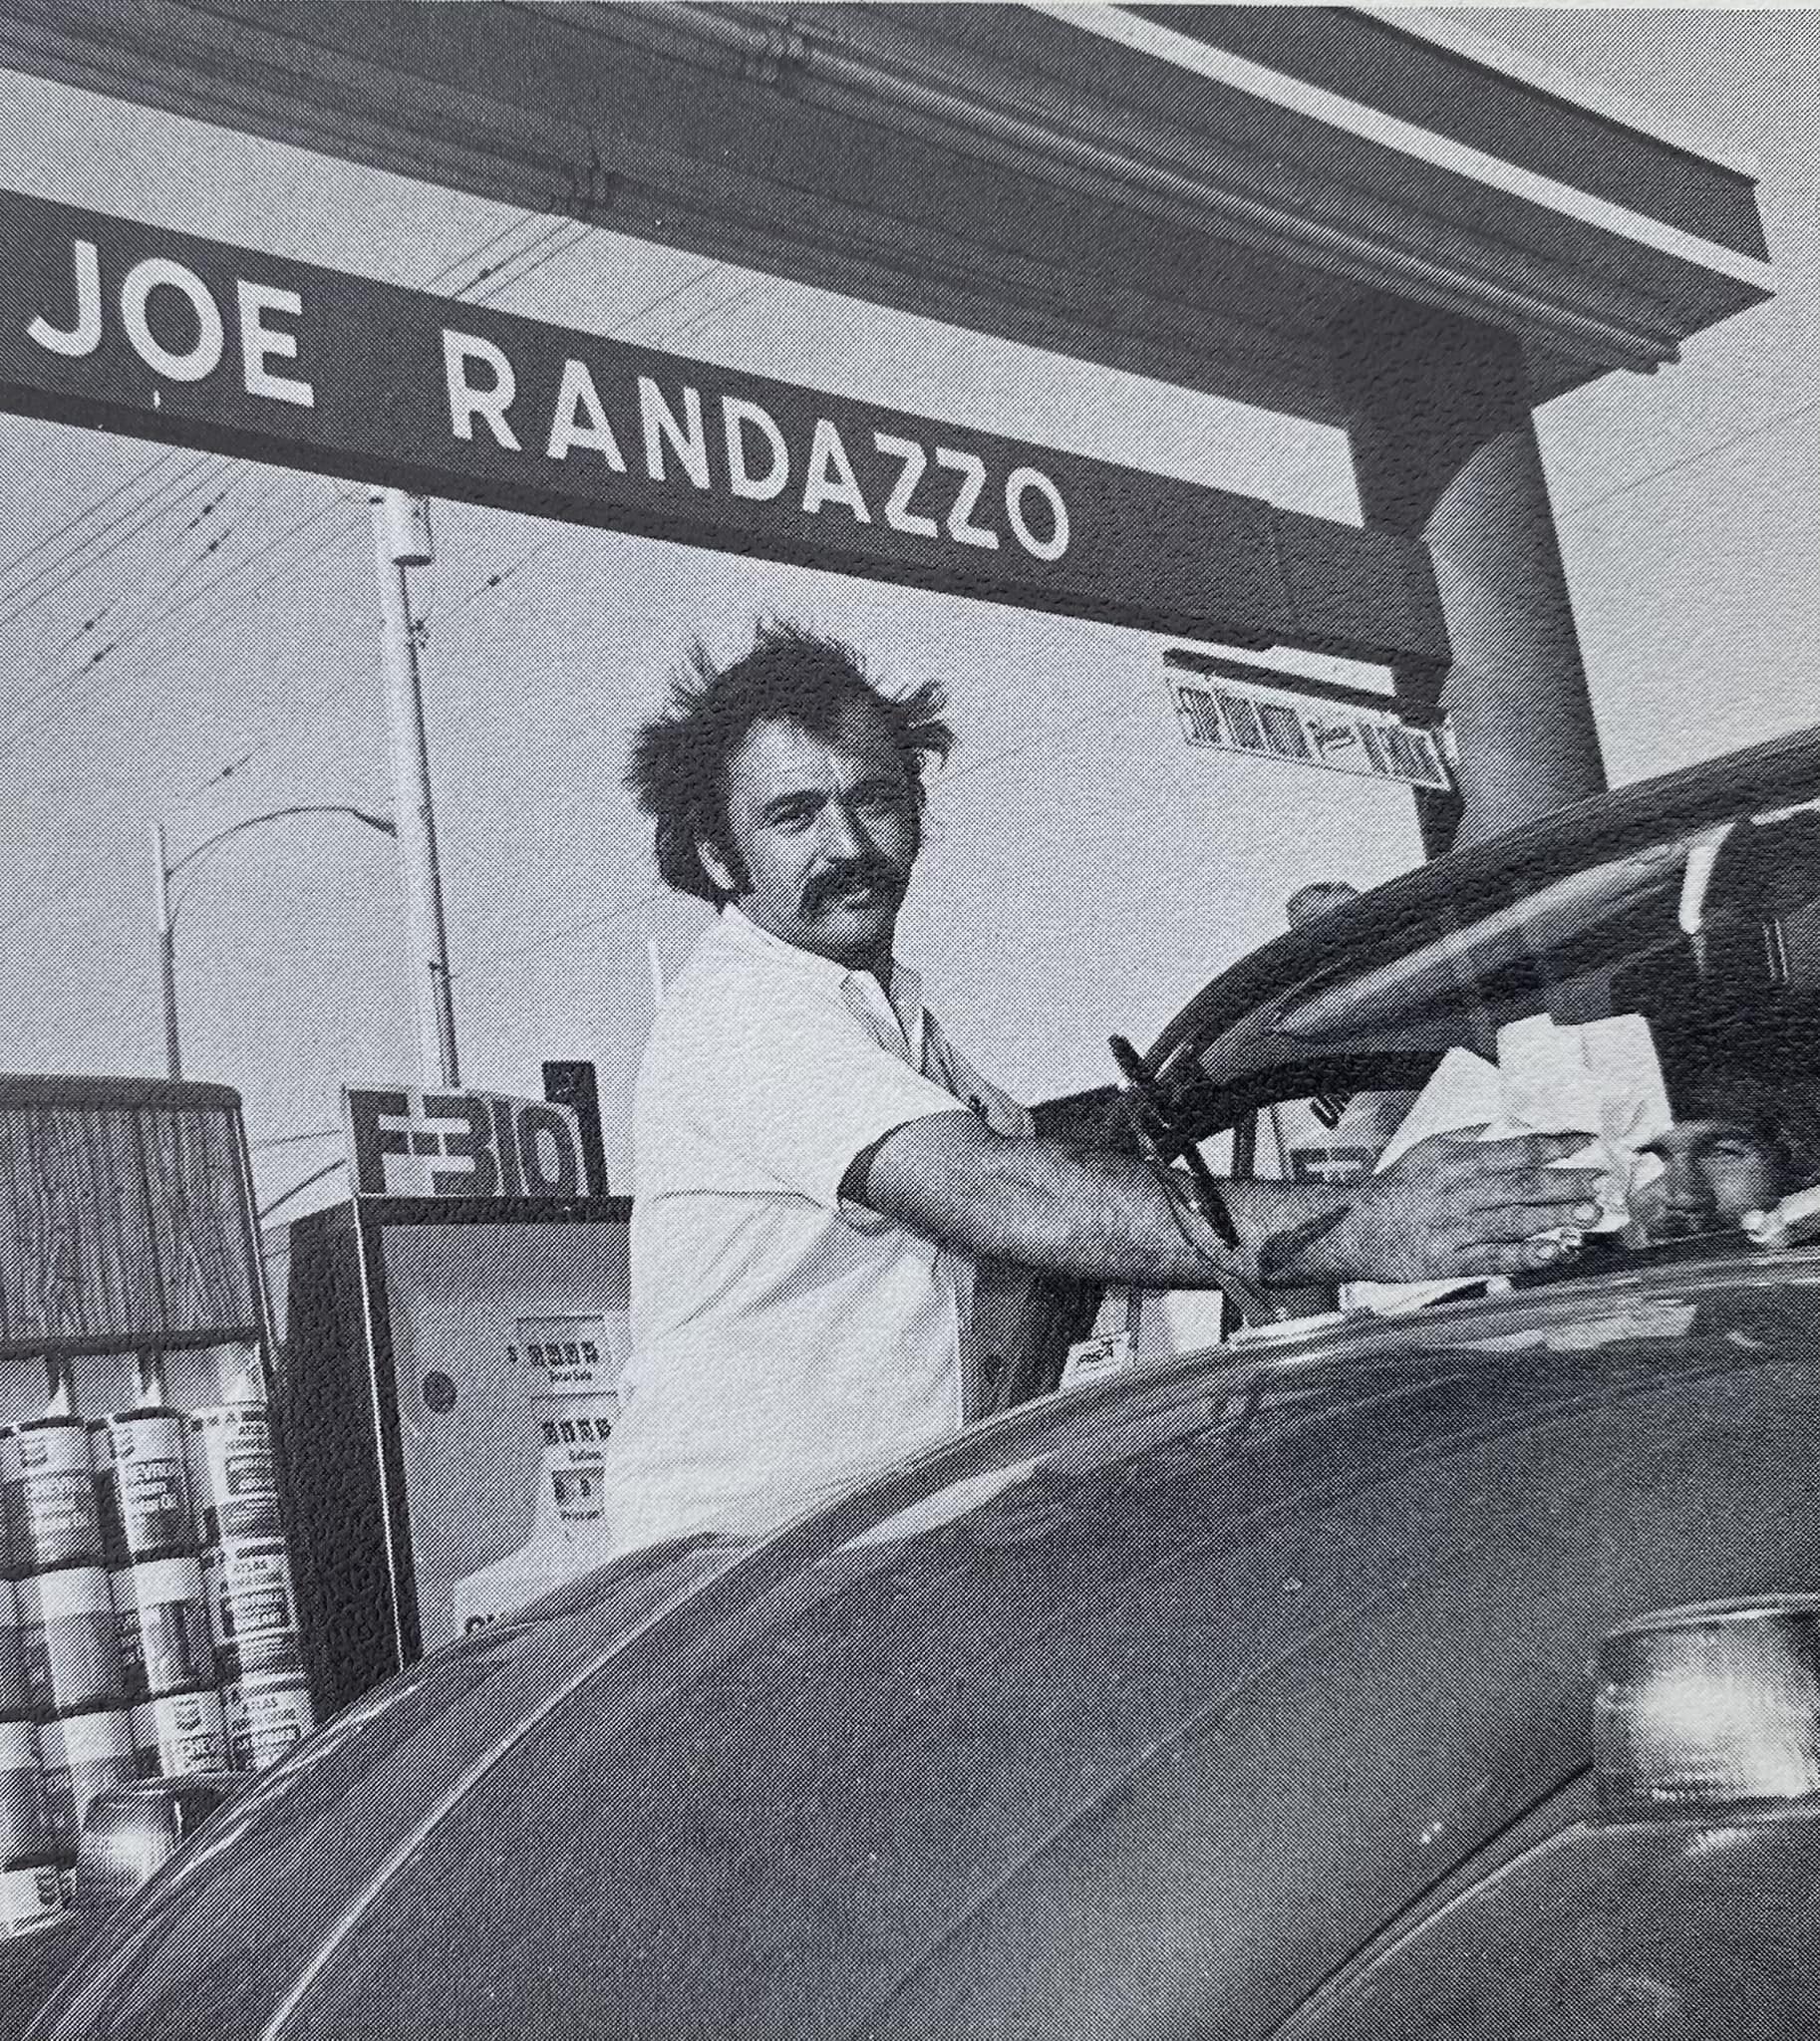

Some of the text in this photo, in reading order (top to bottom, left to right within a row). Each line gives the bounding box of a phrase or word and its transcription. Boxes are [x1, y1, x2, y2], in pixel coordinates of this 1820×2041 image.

[26, 239, 1071, 562] JOE RANDAZZO
[1174, 685, 1224, 745] STOP
